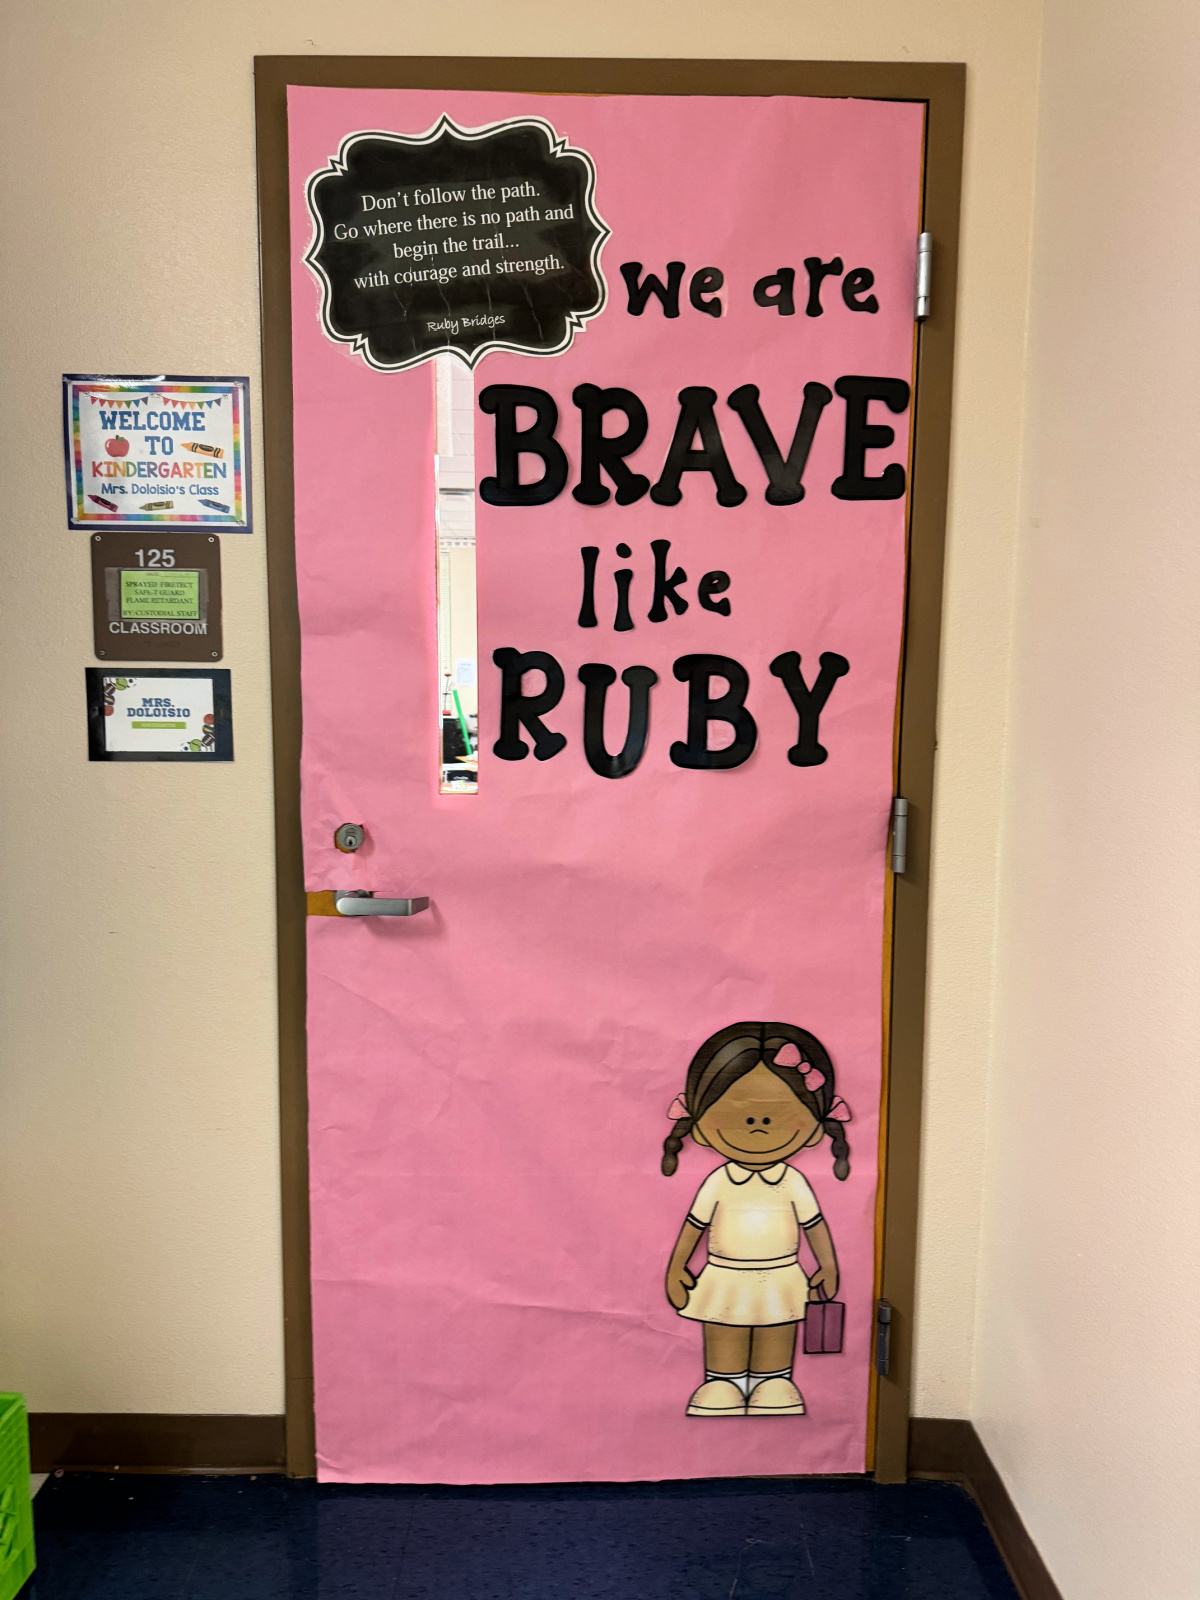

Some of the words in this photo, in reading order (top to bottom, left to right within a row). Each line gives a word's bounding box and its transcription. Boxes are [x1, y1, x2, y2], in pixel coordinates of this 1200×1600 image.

[361, 193, 410, 212] Don’t
[414, 187, 465, 206] follow
[471, 184, 496, 200] the
[501, 181, 540, 202] path.
[334, 224, 358, 240] Go
[363, 217, 412, 236] where
[417, 213, 457, 231] there
[463, 211, 475, 226] is
[481, 211, 501, 224] no
[506, 206, 540, 228] path
[545, 204, 574, 221] and
[393, 240, 438, 261] begin
[443, 237, 467, 254] the
[472, 233, 519, 252] trail...
[354, 271, 389, 289] with
[394, 265, 457, 284] courage
[462, 261, 490, 277] and
[496, 255, 564, 277] strength.
[619, 259, 724, 319] we
[752, 256, 880, 317] are
[426, 319, 459, 334] Ruby
[463, 313, 505, 327] Bridges
[99, 410, 205, 431] WELCOME
[144, 435, 174, 456] TO
[478, 375, 911, 507] BRAVE
[92, 461, 227, 478] KINDERGARTEN
[101, 483, 128, 495] Mrs.
[131, 483, 186, 496] Doloisio's
[189, 484, 219, 496] Class
[134, 548, 176, 567] 125
[577, 539, 732, 632] like
[109, 621, 208, 635] CLASSROOM
[127, 707, 191, 718] DOLOISIO
[141, 698, 175, 707] MRS.
[492, 647, 850, 779] RUBY
